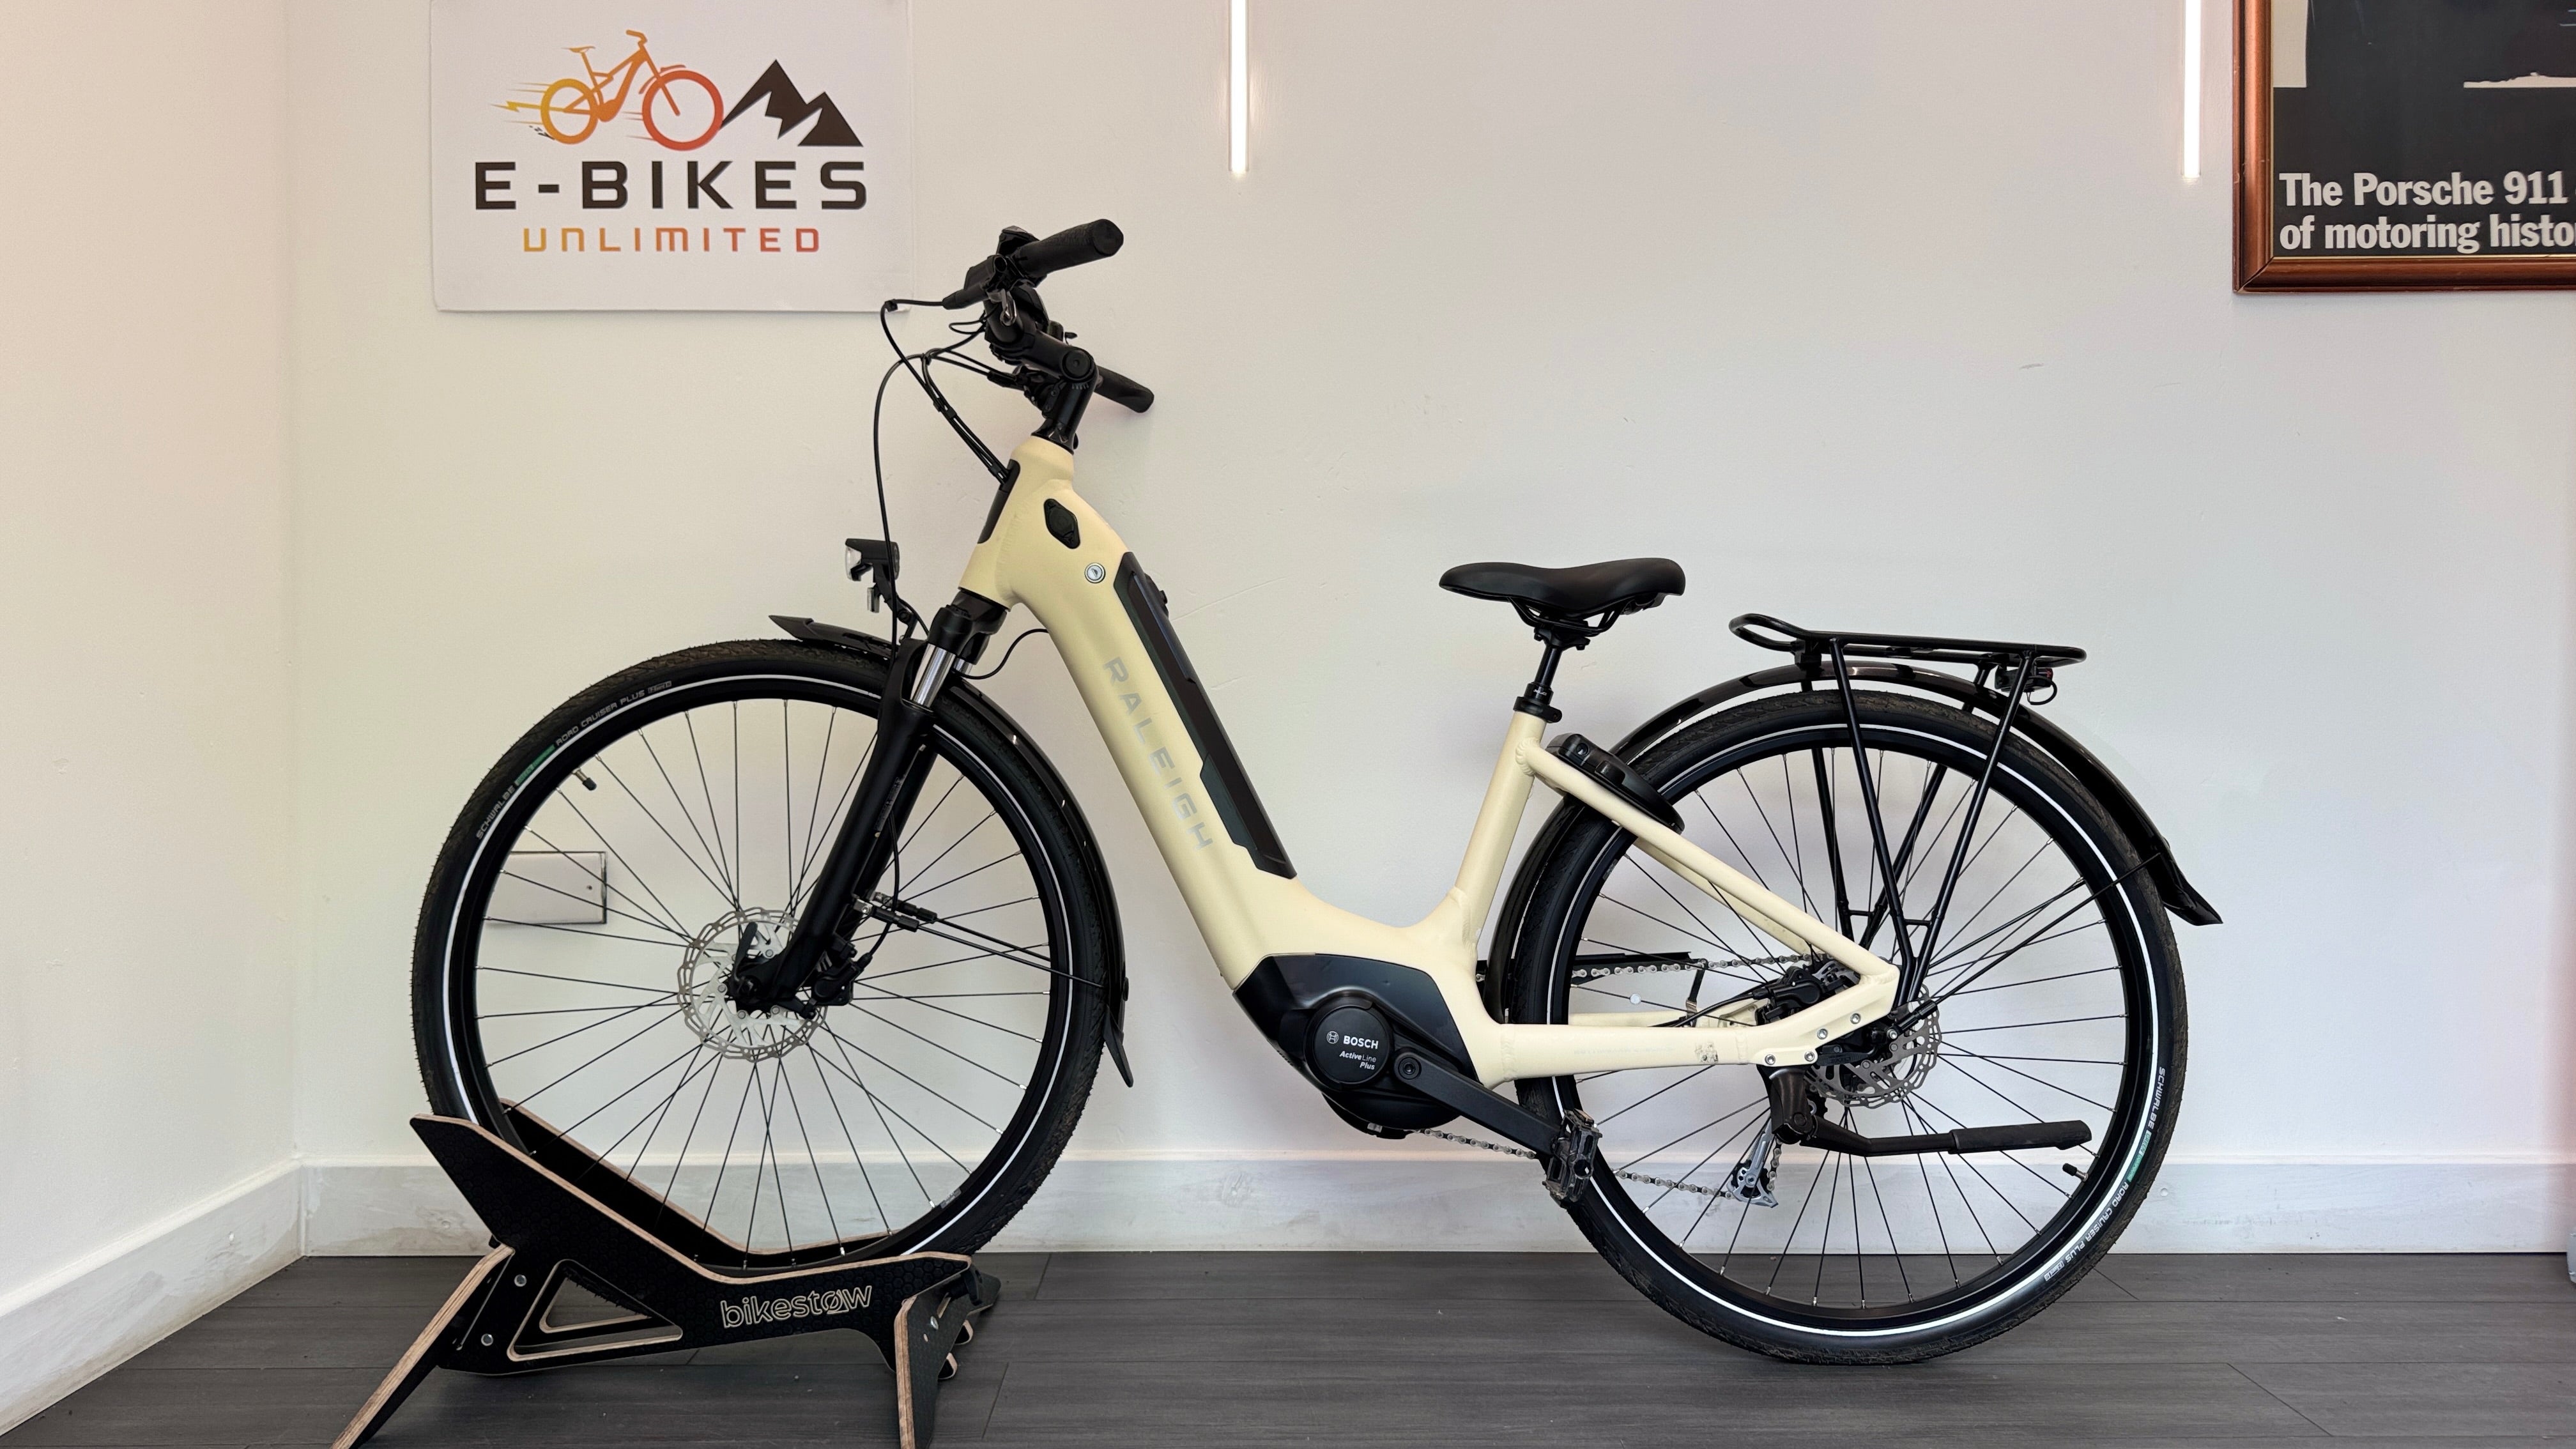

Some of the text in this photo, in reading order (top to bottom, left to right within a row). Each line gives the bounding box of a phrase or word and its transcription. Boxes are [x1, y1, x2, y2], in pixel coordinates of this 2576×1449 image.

[475, 160, 867, 210] E-BIKES
[2279, 171, 2568, 206] The Porsche 911
[523, 227, 820, 253] UNLIMITED
[2279, 213, 2576, 254] of motoring histo
[476, 690, 645, 839] SCHWALBE ROAD CRUISER PLUS
[1103, 656, 1213, 850] RALEIGH
[1344, 1035, 1379, 1050] BOSCH
[1360, 1061, 1376, 1070] Plus
[2148, 1066, 2165, 1130] SCHWALBE
[2112, 1182, 2129, 1208] ROAD
[2085, 1208, 2113, 1242] CRUISER
[2066, 1241, 2085, 1263] PLUS
